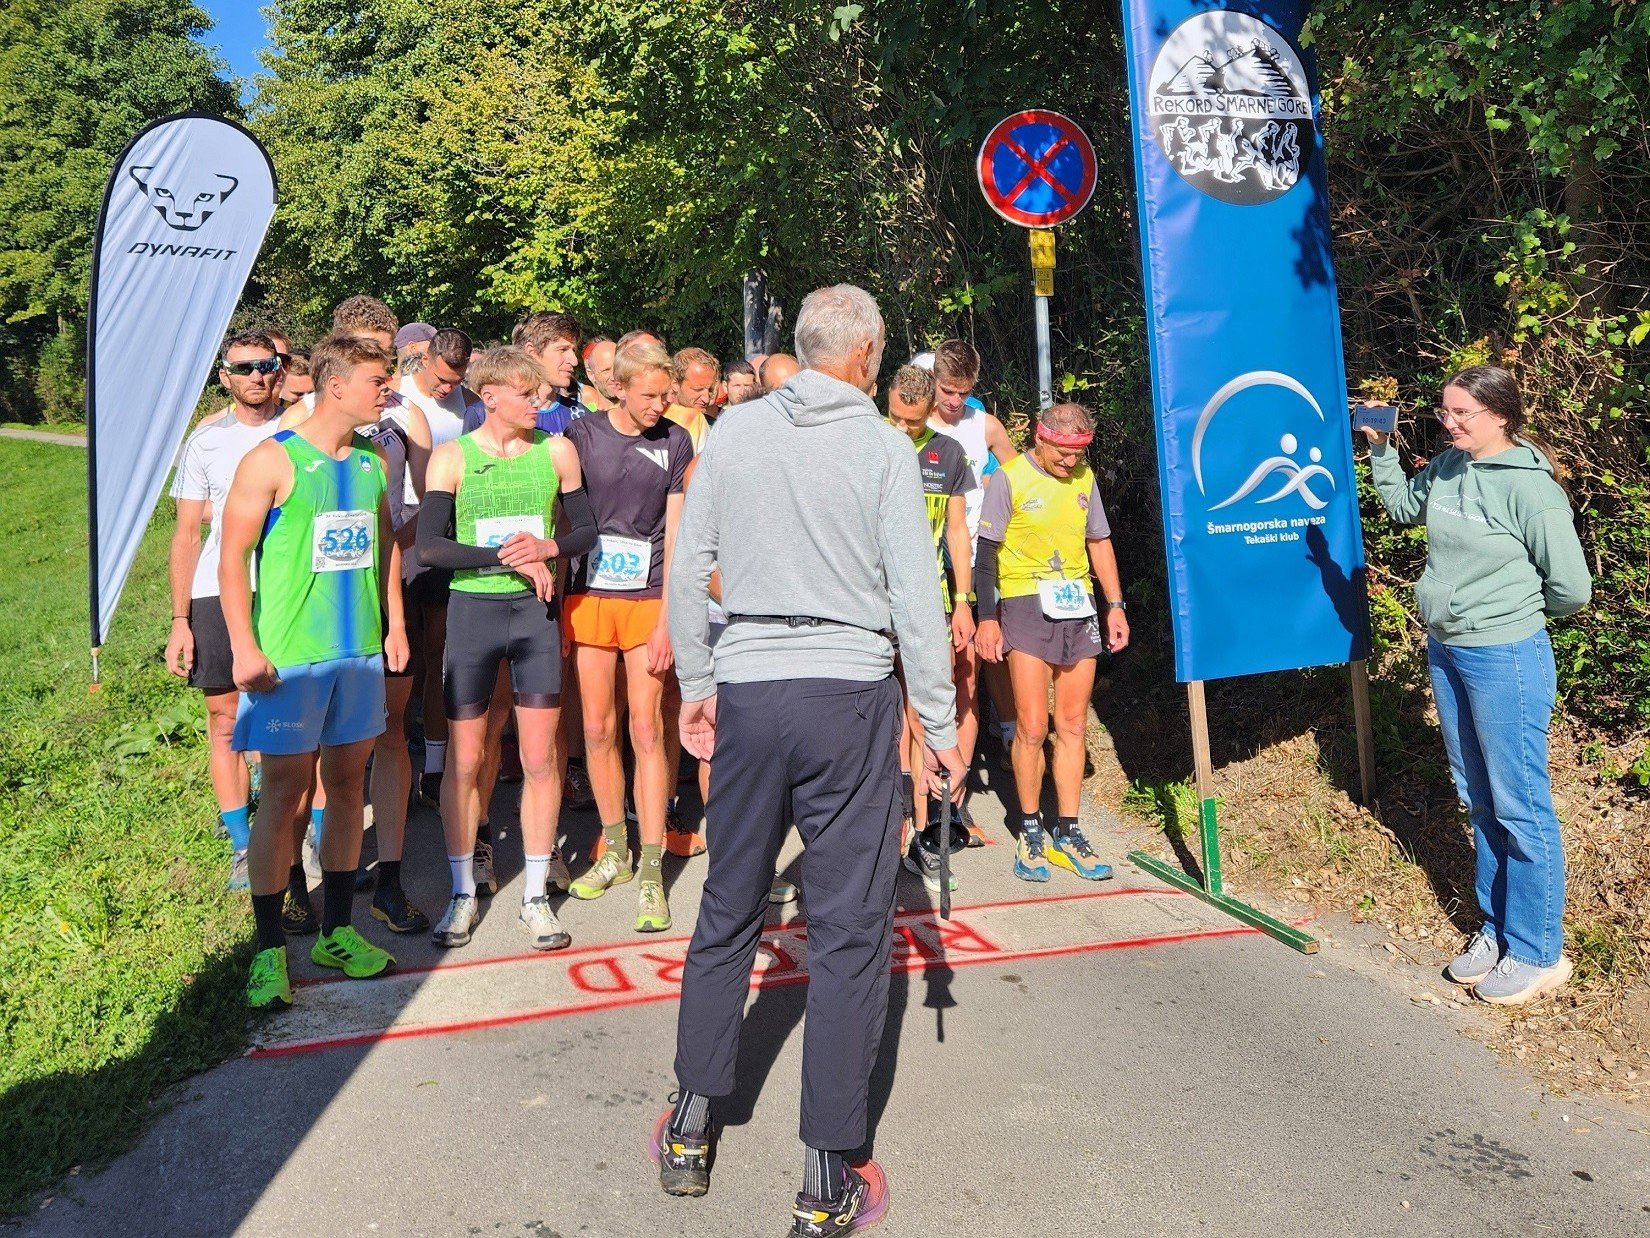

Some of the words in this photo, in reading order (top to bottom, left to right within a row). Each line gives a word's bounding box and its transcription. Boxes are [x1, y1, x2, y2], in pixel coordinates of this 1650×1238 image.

[1216, 90, 1275, 115] ŠMARNE
[1277, 98, 1309, 116] GORE
[127, 242, 238, 261] DYNAFIT
[1207, 518, 1288, 534] Šmarnogorska
[1291, 515, 1326, 527] naveza
[322, 526, 371, 553] 526
[1244, 533, 1278, 545] Tekaški
[1280, 532, 1300, 542] klub
